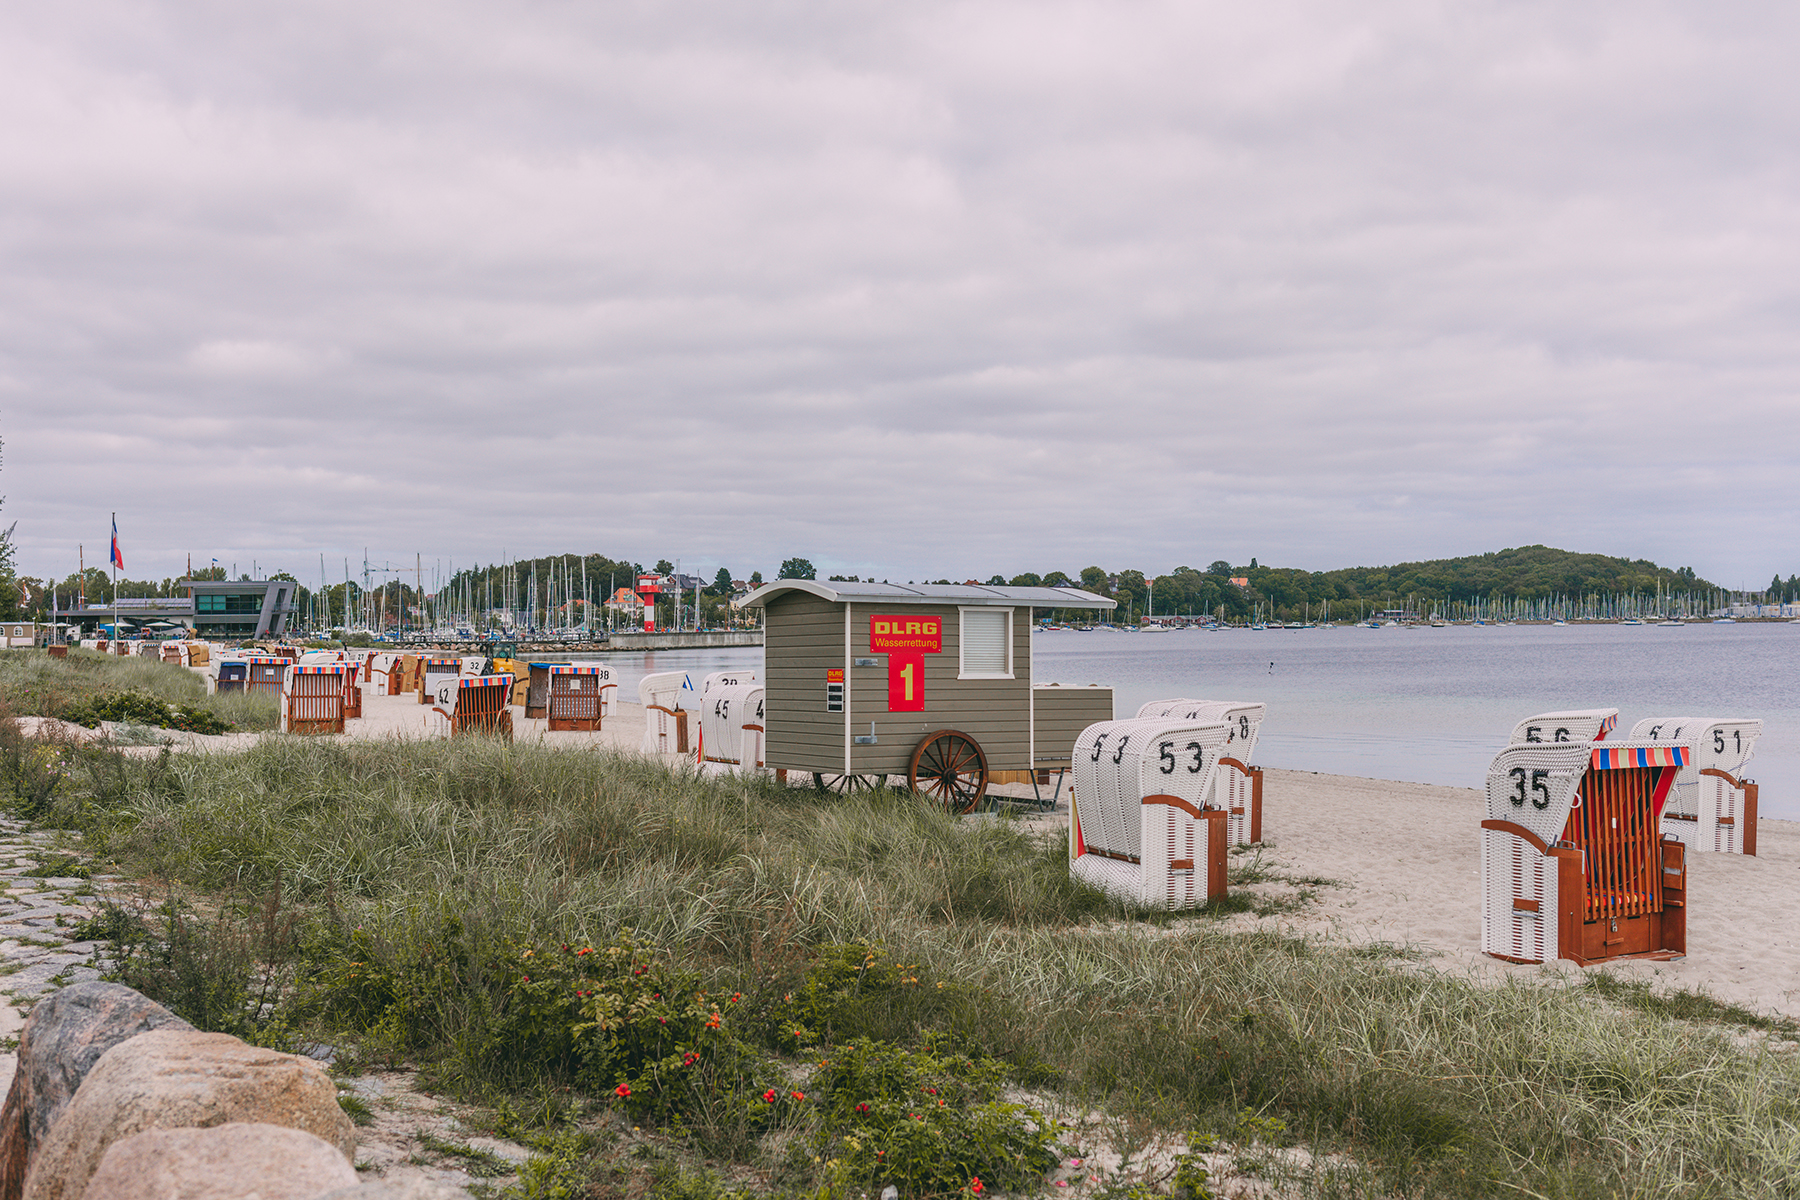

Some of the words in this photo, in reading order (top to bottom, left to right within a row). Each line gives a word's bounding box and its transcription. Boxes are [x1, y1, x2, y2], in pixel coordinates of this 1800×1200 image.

[875, 622, 938, 635] DLRG
[875, 638, 938, 649] Wasserrettung
[384, 656, 389, 665] 1
[470, 662, 480, 670] 32
[900, 663, 913, 701] 1
[439, 687, 449, 705] 42
[715, 699, 730, 720] 45
[1091, 733, 1130, 764] 53
[1713, 729, 1742, 754] 51
[1159, 741, 1203, 775] 53
[1509, 767, 1550, 810] 35
